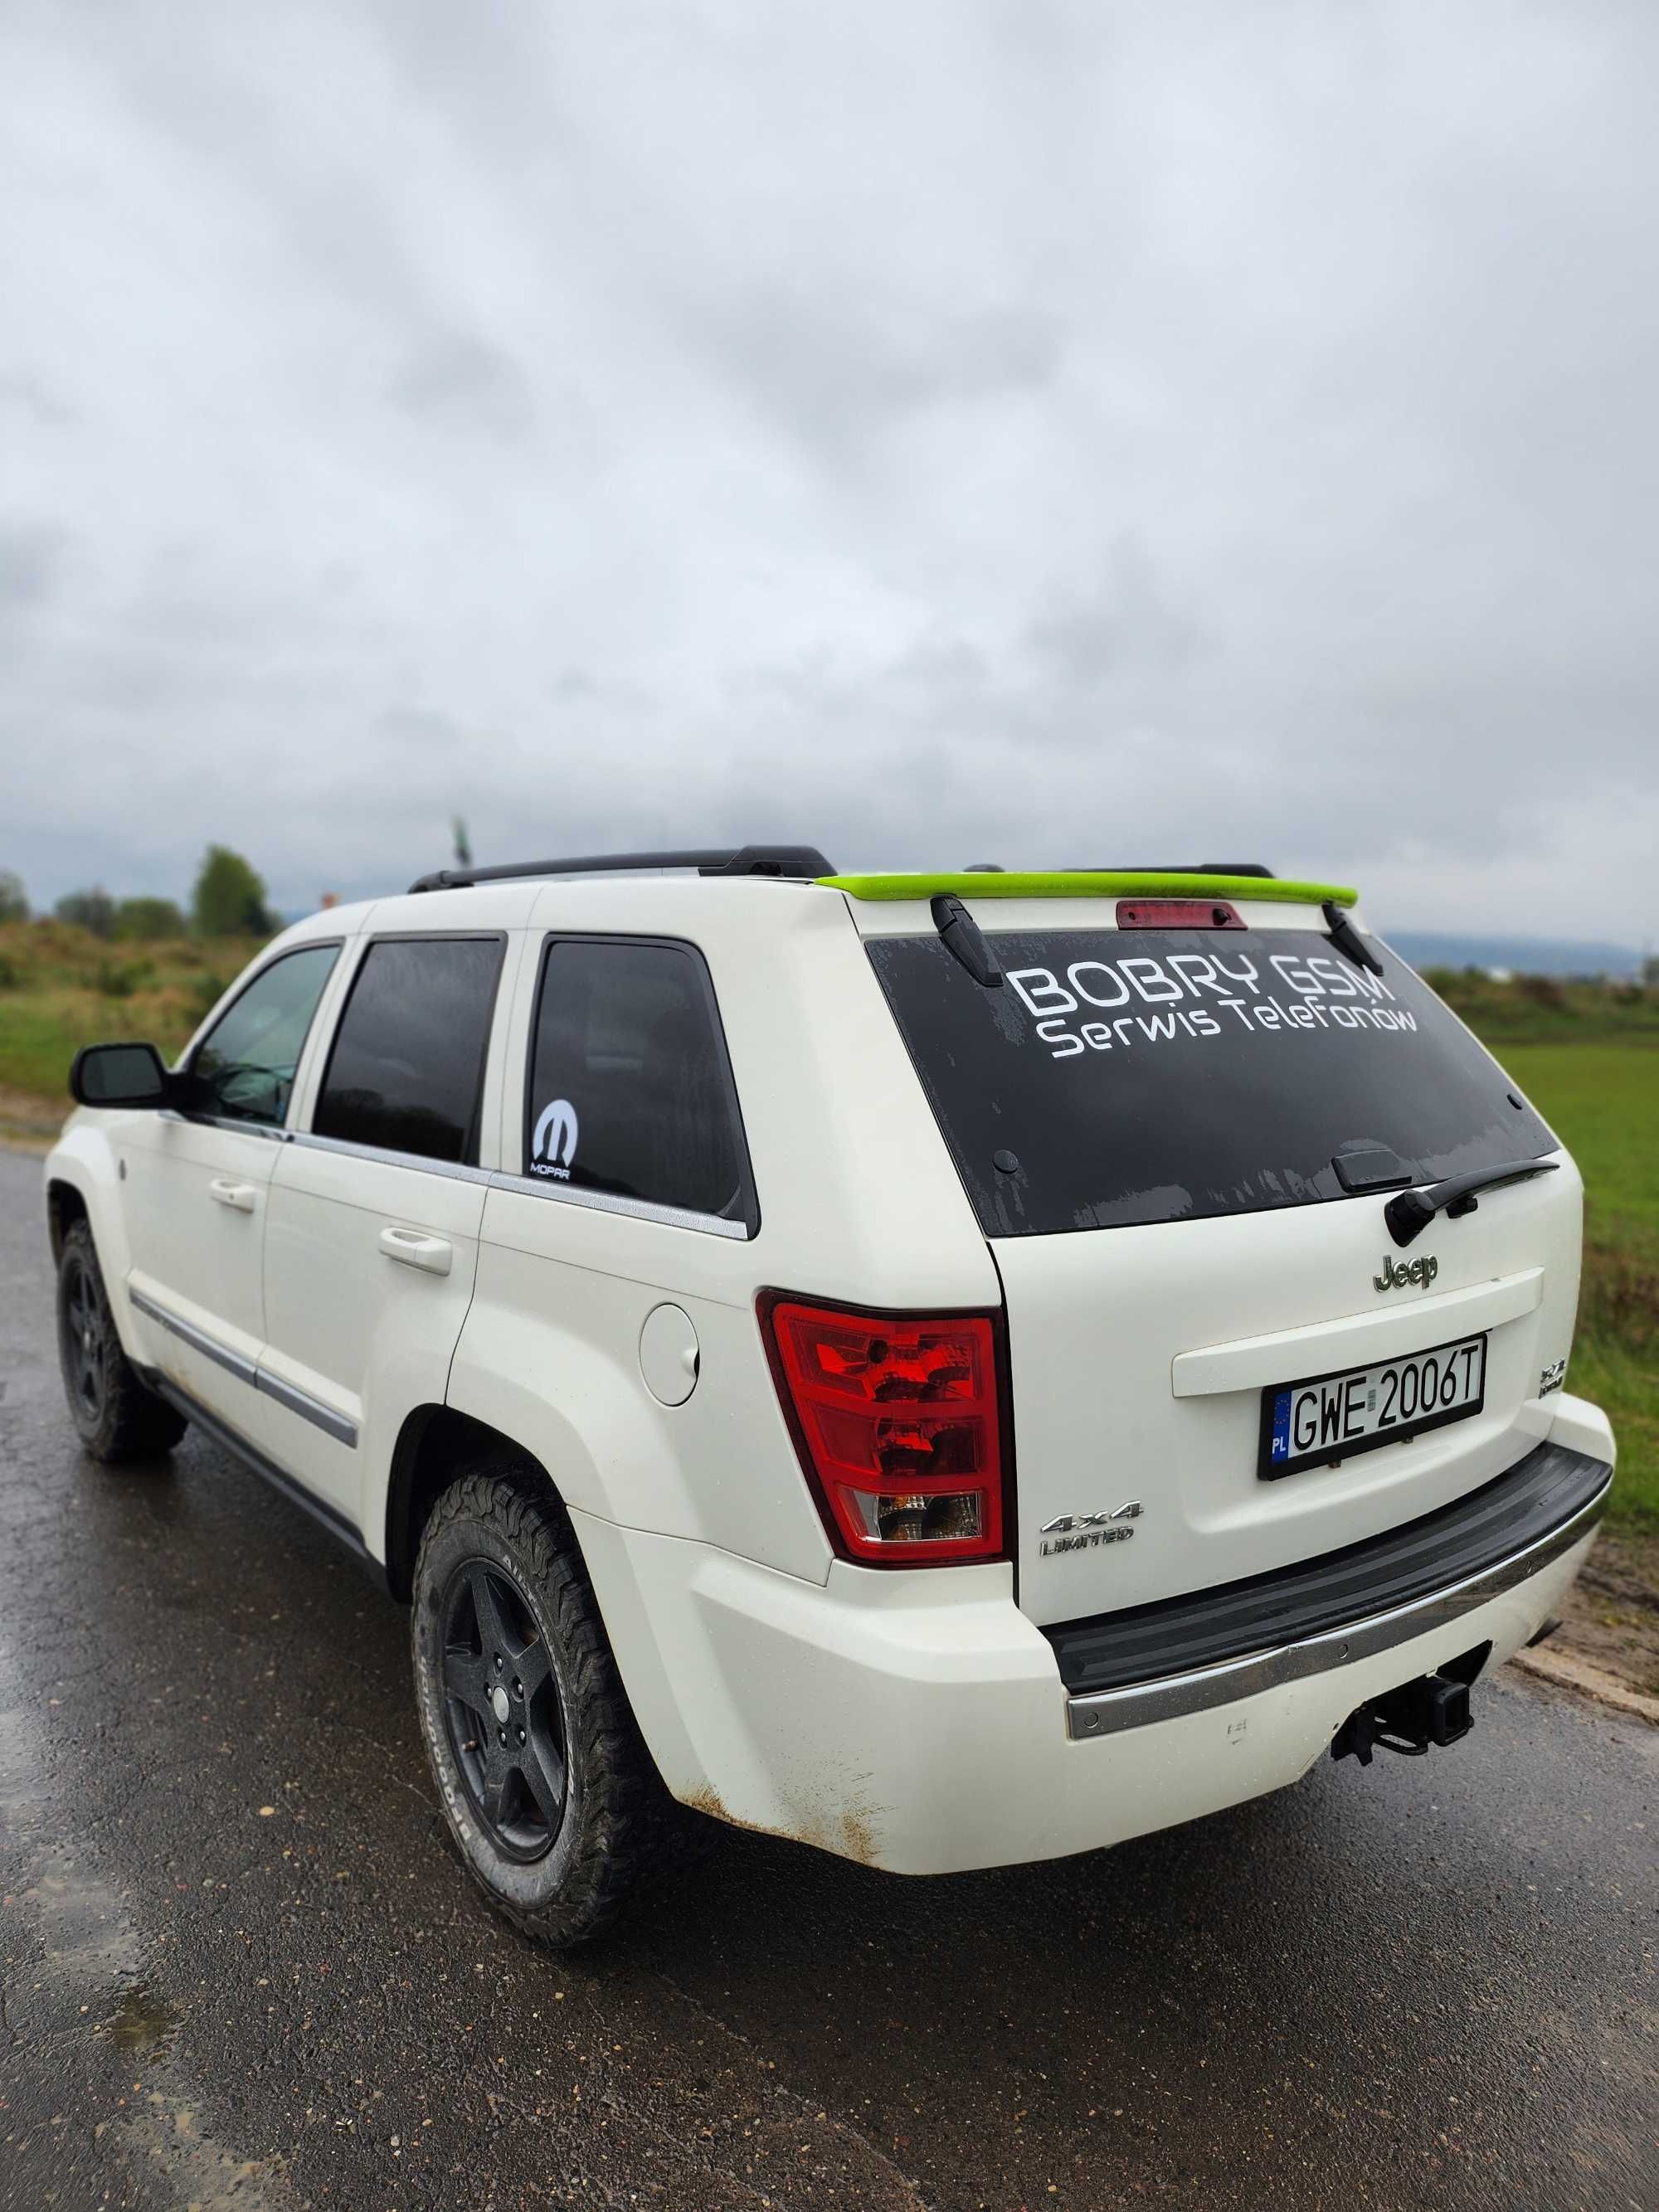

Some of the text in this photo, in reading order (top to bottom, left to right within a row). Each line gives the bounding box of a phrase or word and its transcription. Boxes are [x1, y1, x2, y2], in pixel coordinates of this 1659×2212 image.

[1006, 955, 1396, 1017] BOBRY GSM
[1036, 1002, 1221, 1058] Serwis
[530, 1162, 571, 1179] MOPAR
[1373, 1253, 1438, 1294] Jeep
[1293, 1344, 1479, 1451] GWE 2006T
[1272, 1436, 1287, 1454] PL
[1040, 1525, 1135, 1557] LIMITED
